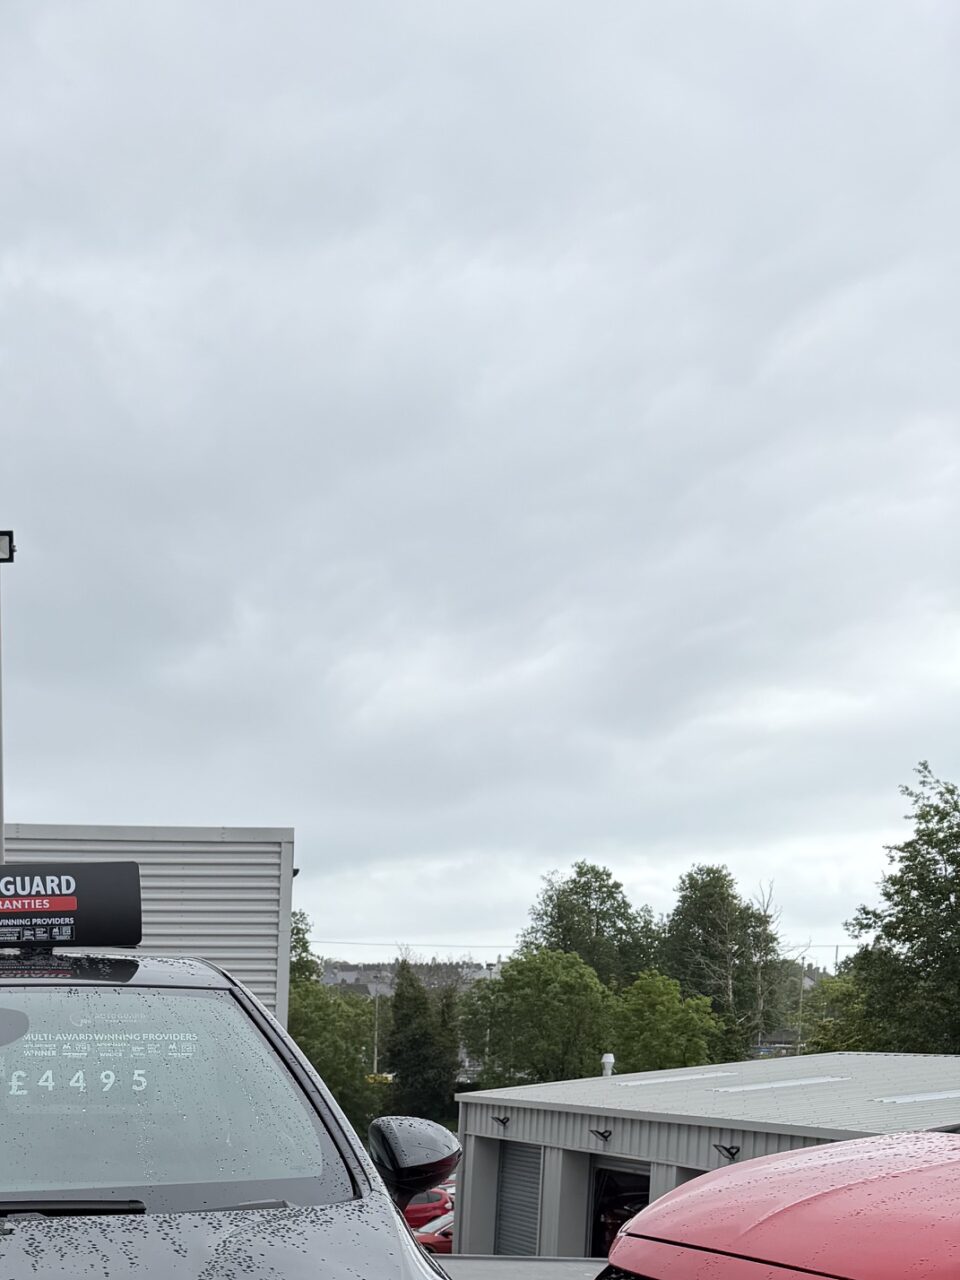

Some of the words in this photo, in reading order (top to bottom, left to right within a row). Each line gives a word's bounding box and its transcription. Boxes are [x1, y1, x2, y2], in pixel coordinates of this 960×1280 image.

[32, 917, 75, 925] PROVIDERS
[93, 1033, 141, 1041] WINNING
[143, 1032, 198, 1041] PROVIDERS
